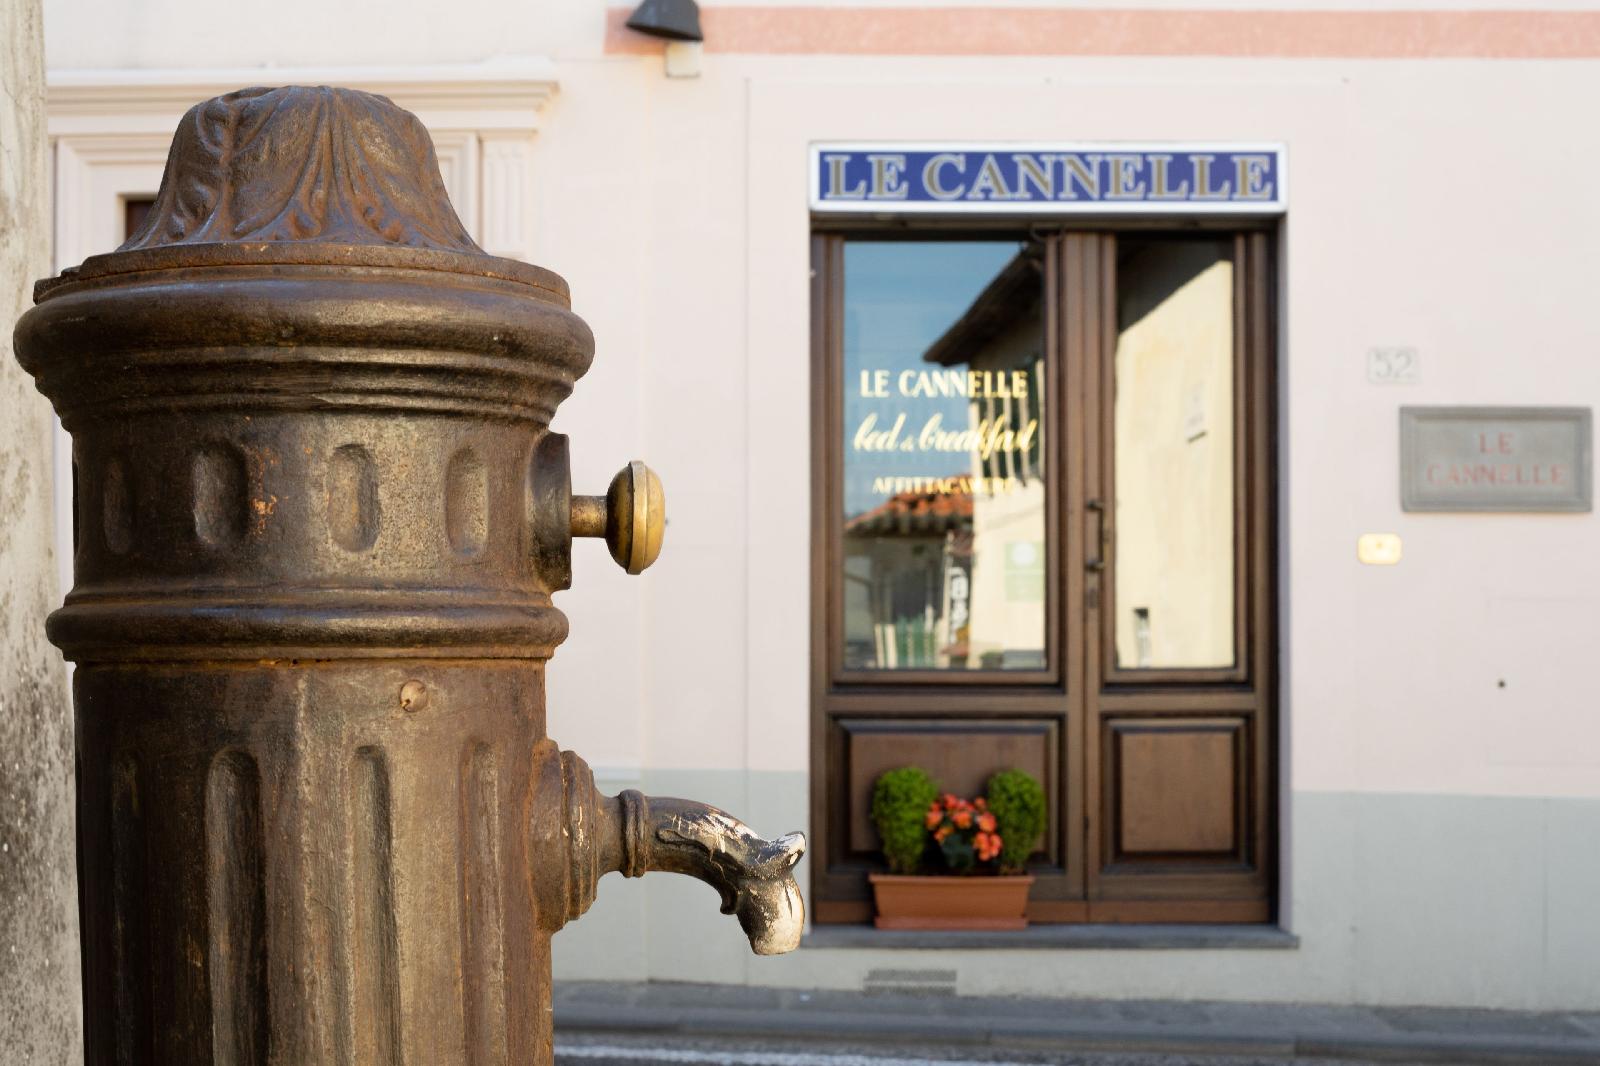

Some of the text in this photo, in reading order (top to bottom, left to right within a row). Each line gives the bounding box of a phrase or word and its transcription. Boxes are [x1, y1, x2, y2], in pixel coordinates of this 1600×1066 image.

[824, 154, 1274, 200] LE CANNELLE
[1373, 350, 1414, 379] 52
[860, 369, 1029, 399] LE CANNELLE
[853, 412, 907, 451] bed
[1478, 432, 1516, 454] LE
[1426, 463, 1571, 485] CANNELLE
